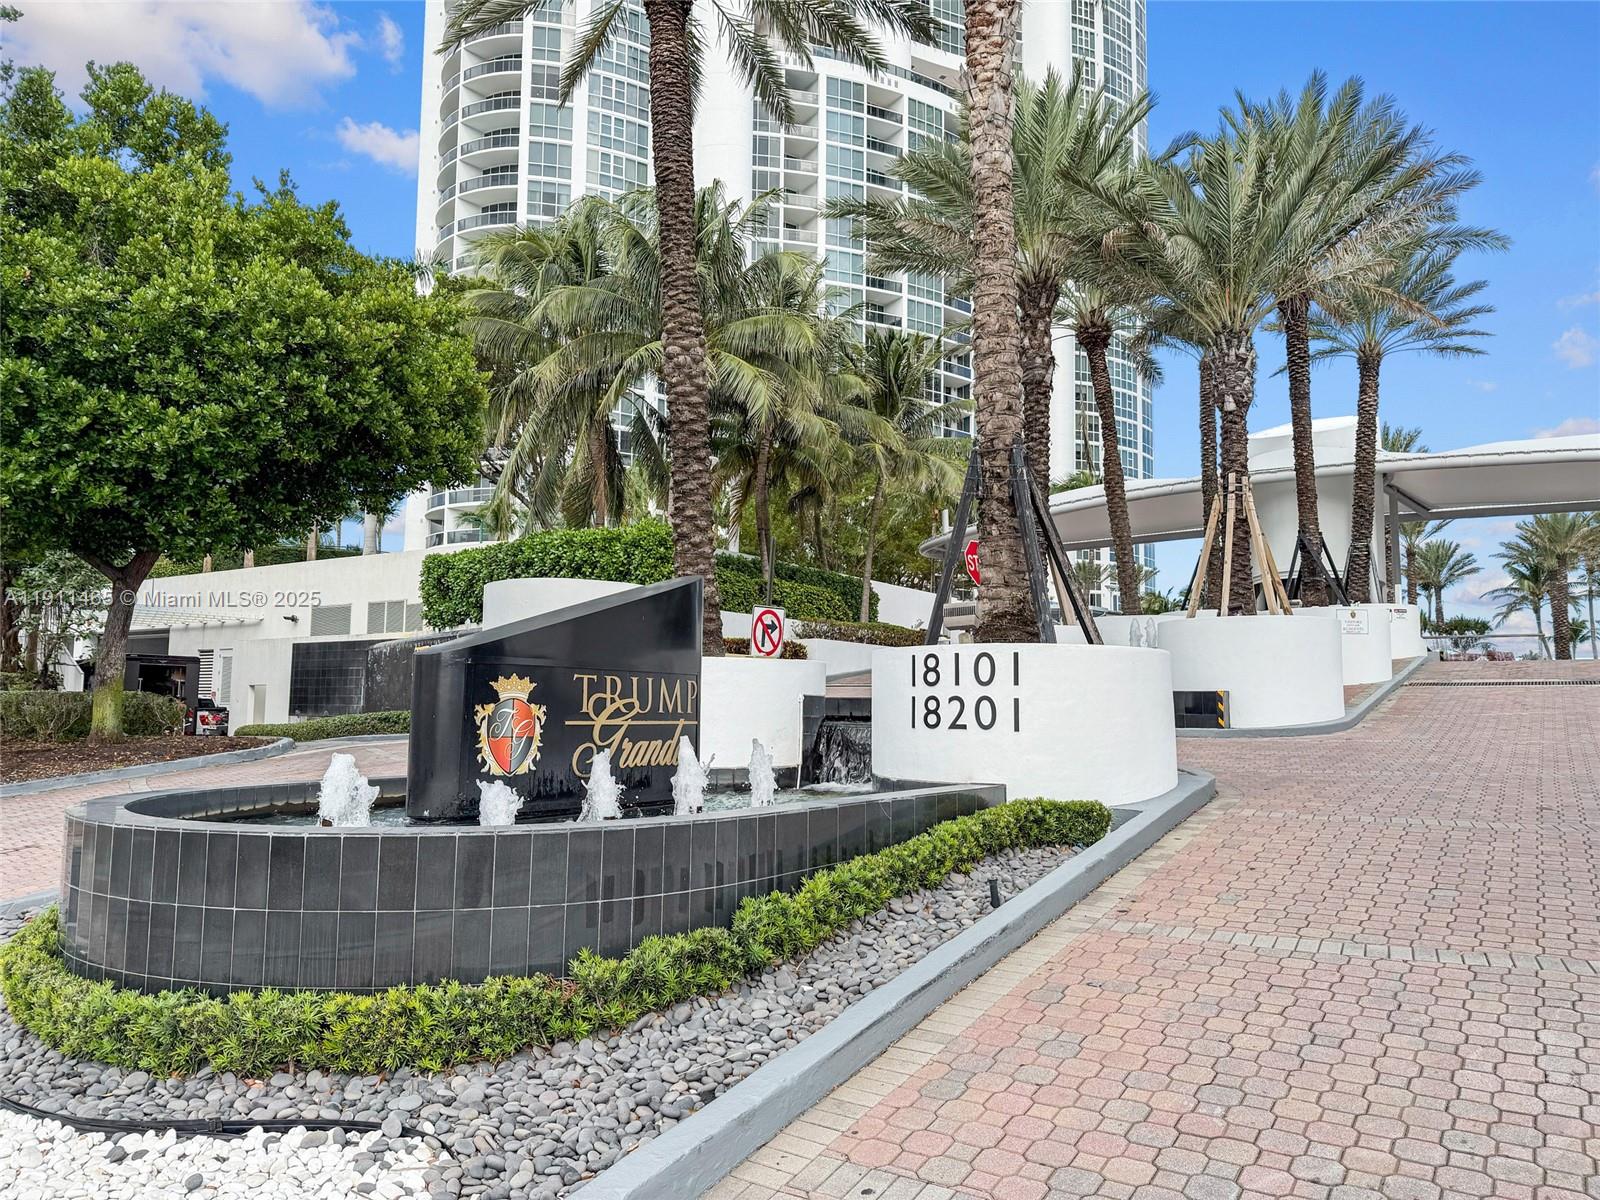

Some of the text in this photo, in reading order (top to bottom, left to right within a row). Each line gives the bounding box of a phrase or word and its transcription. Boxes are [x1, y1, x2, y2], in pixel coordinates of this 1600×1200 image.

[912, 651, 1019, 687] 18101
[573, 674, 697, 714] TRUMP
[912, 695, 1020, 732] 18201
[572, 692, 685, 777] Grand
